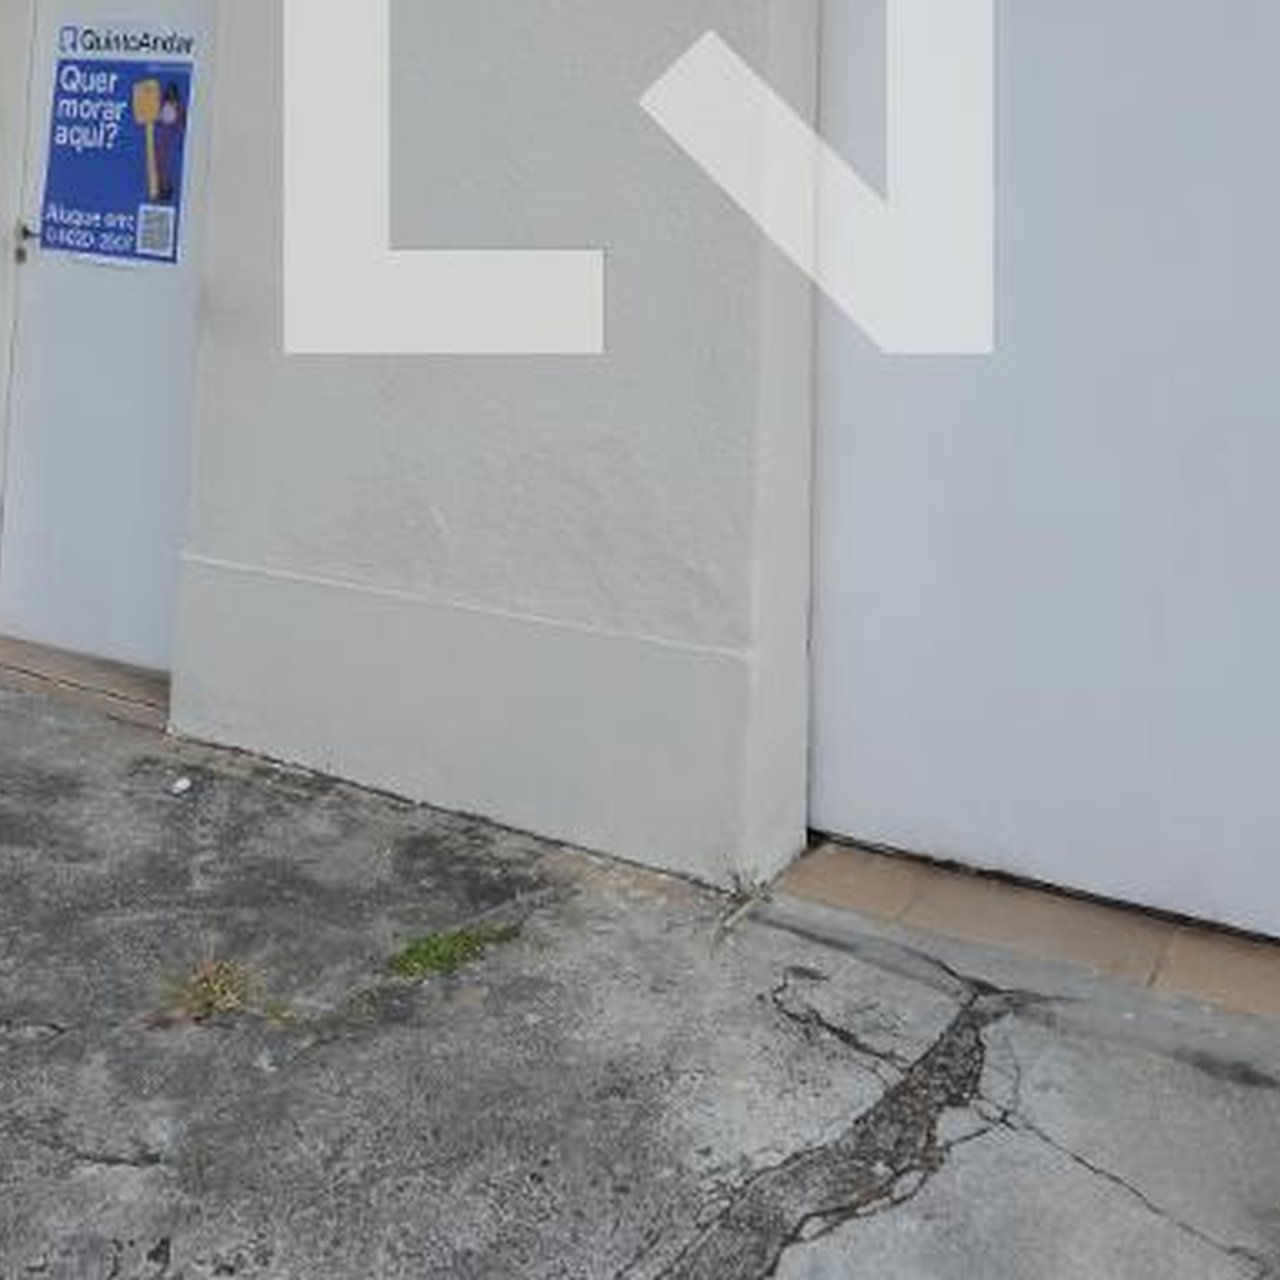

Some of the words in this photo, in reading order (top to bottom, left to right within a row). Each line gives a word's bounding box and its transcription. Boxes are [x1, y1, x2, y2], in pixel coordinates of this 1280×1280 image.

[81, 29, 193, 54] QuintoAndar
[60, 65, 117, 93] Quer
[56, 98, 127, 120] morar
[54, 122, 118, 151] aqui?
